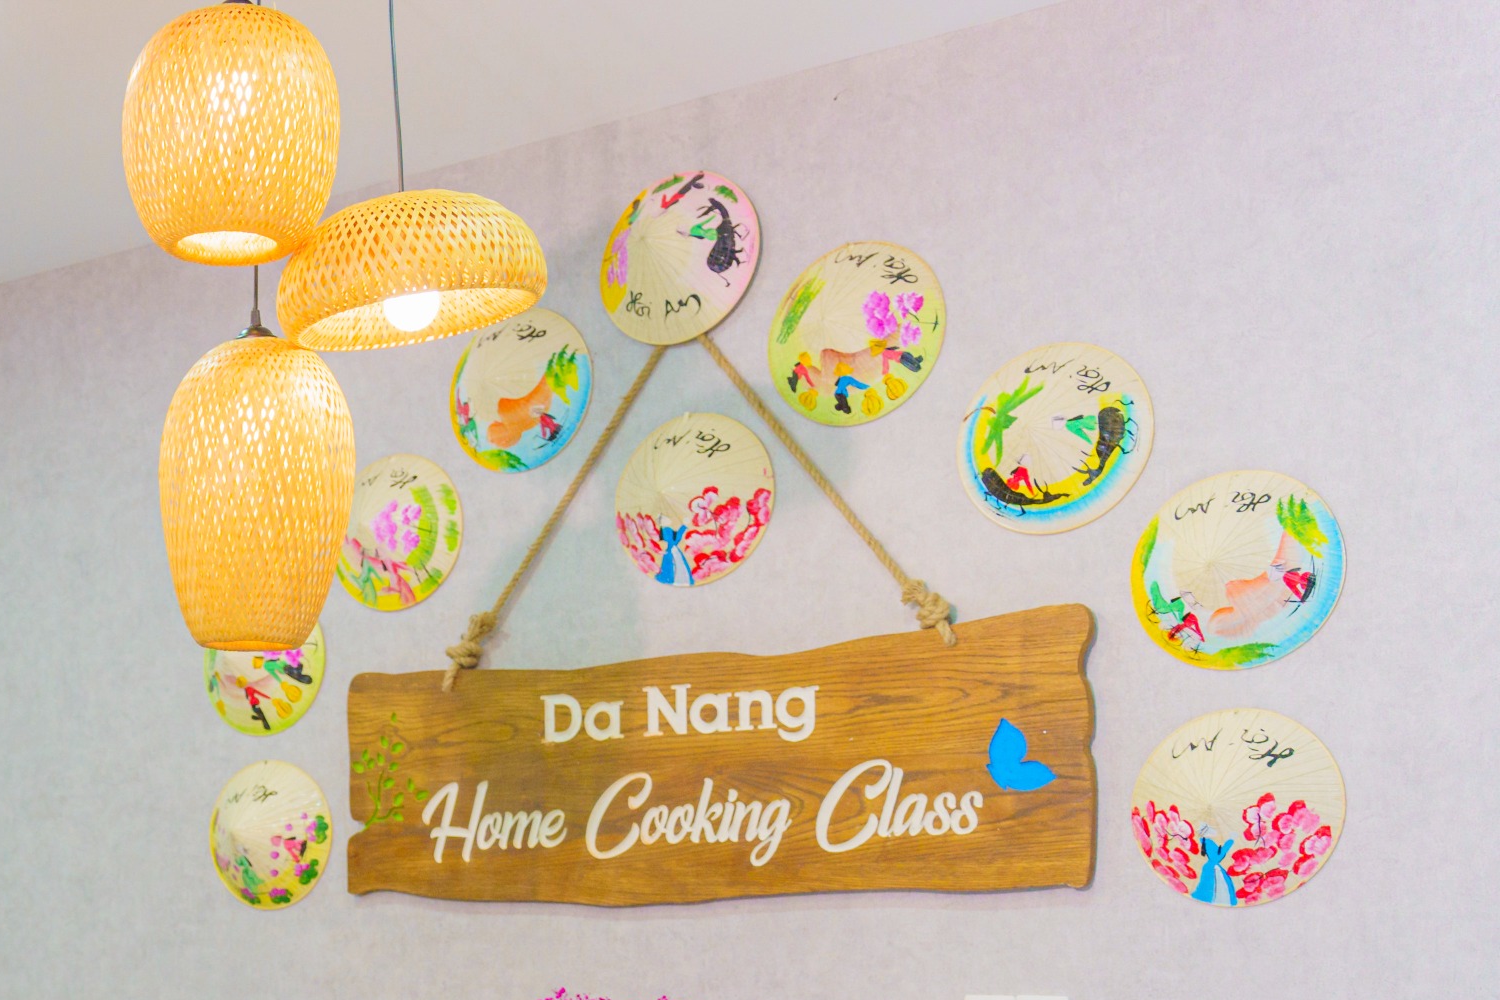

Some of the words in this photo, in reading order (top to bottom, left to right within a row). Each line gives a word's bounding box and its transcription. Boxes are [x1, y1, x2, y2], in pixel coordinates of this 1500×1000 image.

[540, 694, 624, 744] Da
[642, 683, 820, 742] Nang
[422, 781, 567, 863] Home
[585, 771, 792, 866] Cooking
[815, 758, 983, 853] Class
